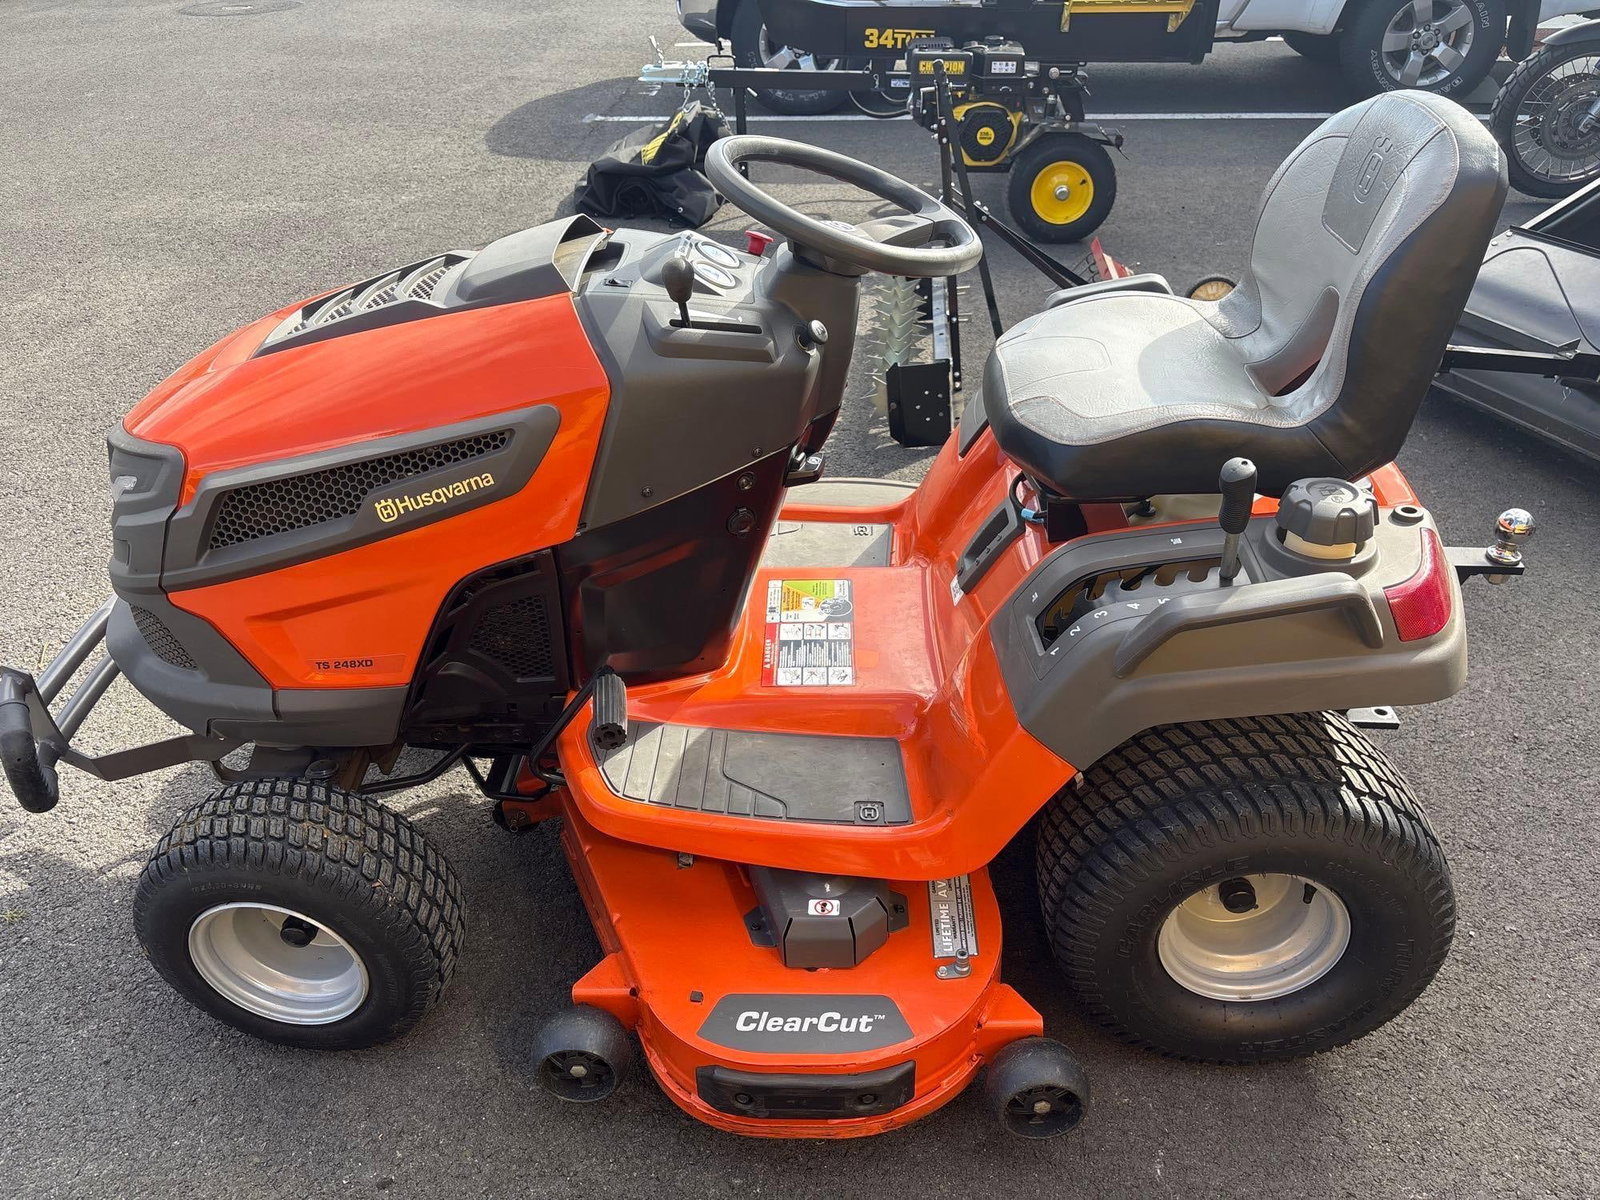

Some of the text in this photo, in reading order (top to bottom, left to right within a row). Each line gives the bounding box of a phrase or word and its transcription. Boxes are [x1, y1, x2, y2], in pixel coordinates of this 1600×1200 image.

[395, 472, 495, 515] Husqvarna
[1050, 647, 1060, 656] 1
[1069, 625, 1081, 637] 2
[1094, 610, 1108, 619] 3
[1127, 602, 1140, 610] 4
[315, 659, 374, 670] TS 248XD
[939, 903, 953, 952] LIFETIME
